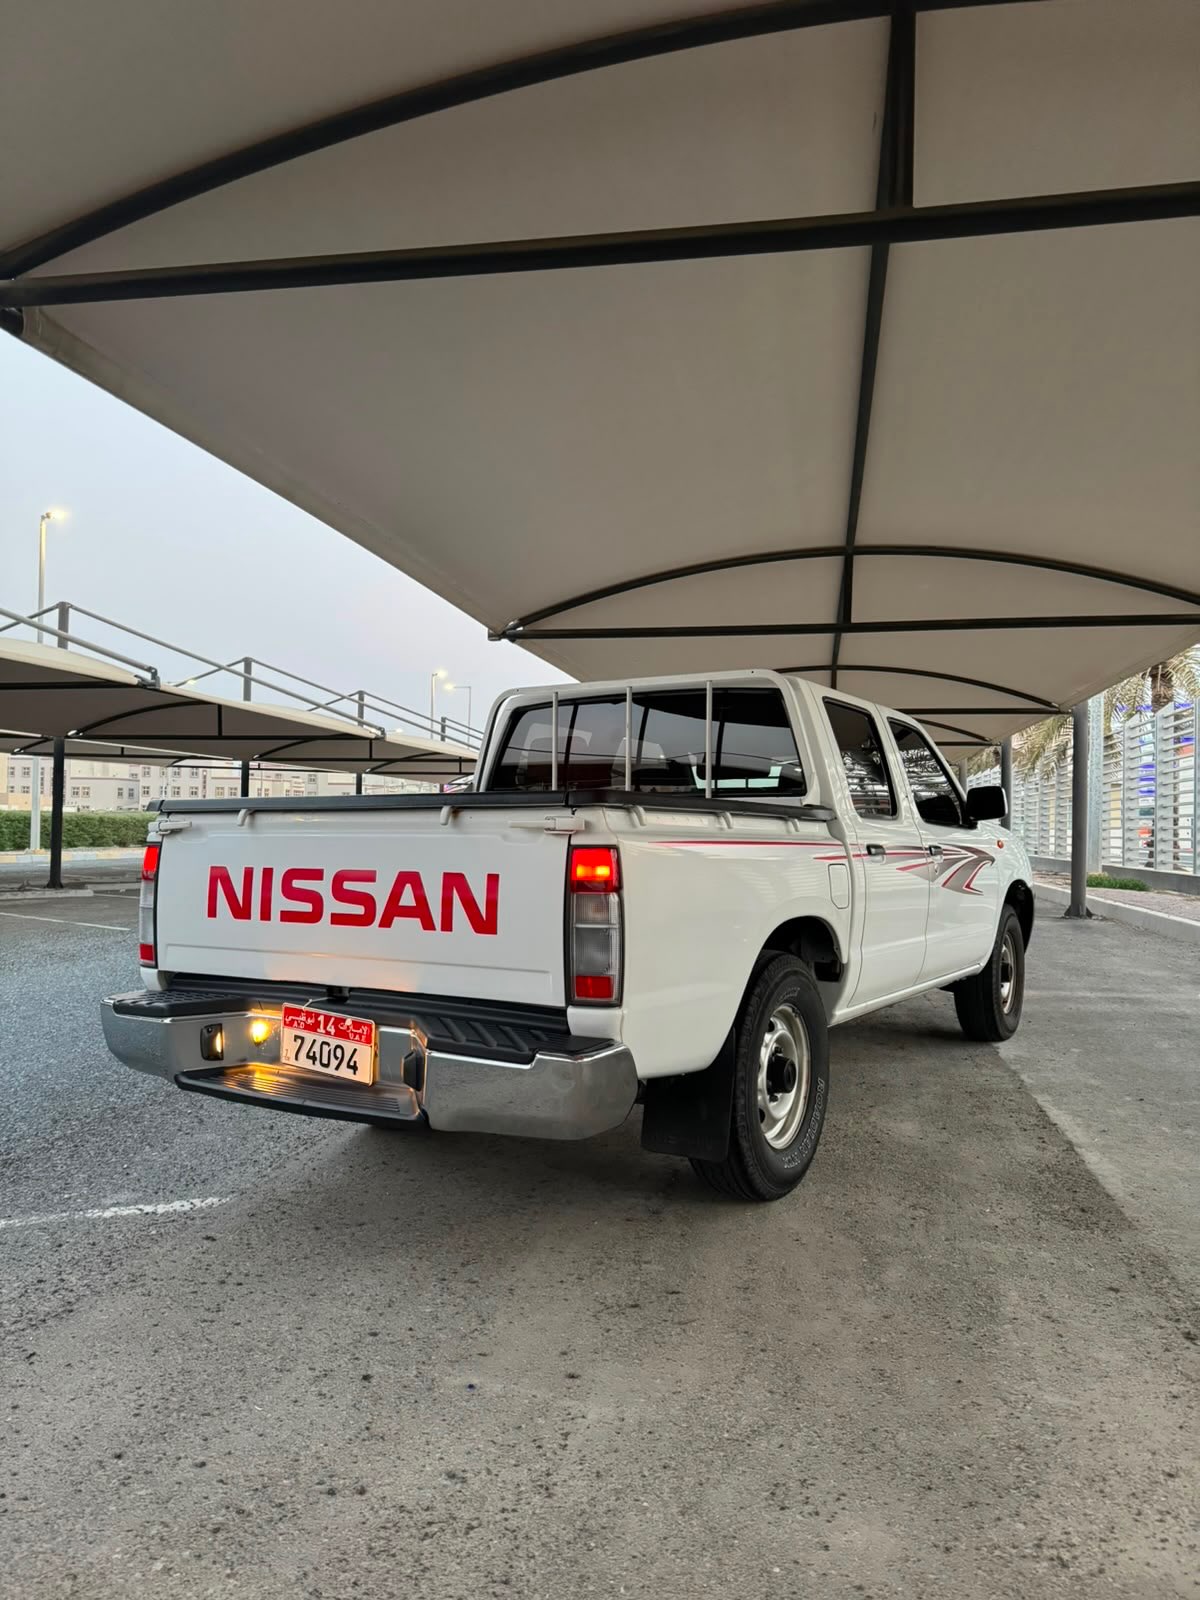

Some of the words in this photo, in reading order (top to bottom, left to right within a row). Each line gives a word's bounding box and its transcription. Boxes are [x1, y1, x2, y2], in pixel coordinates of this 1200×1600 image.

[207, 865, 500, 935] NISSAN
[317, 1014, 335, 1035] 14
[293, 1034, 358, 1075] 74094
